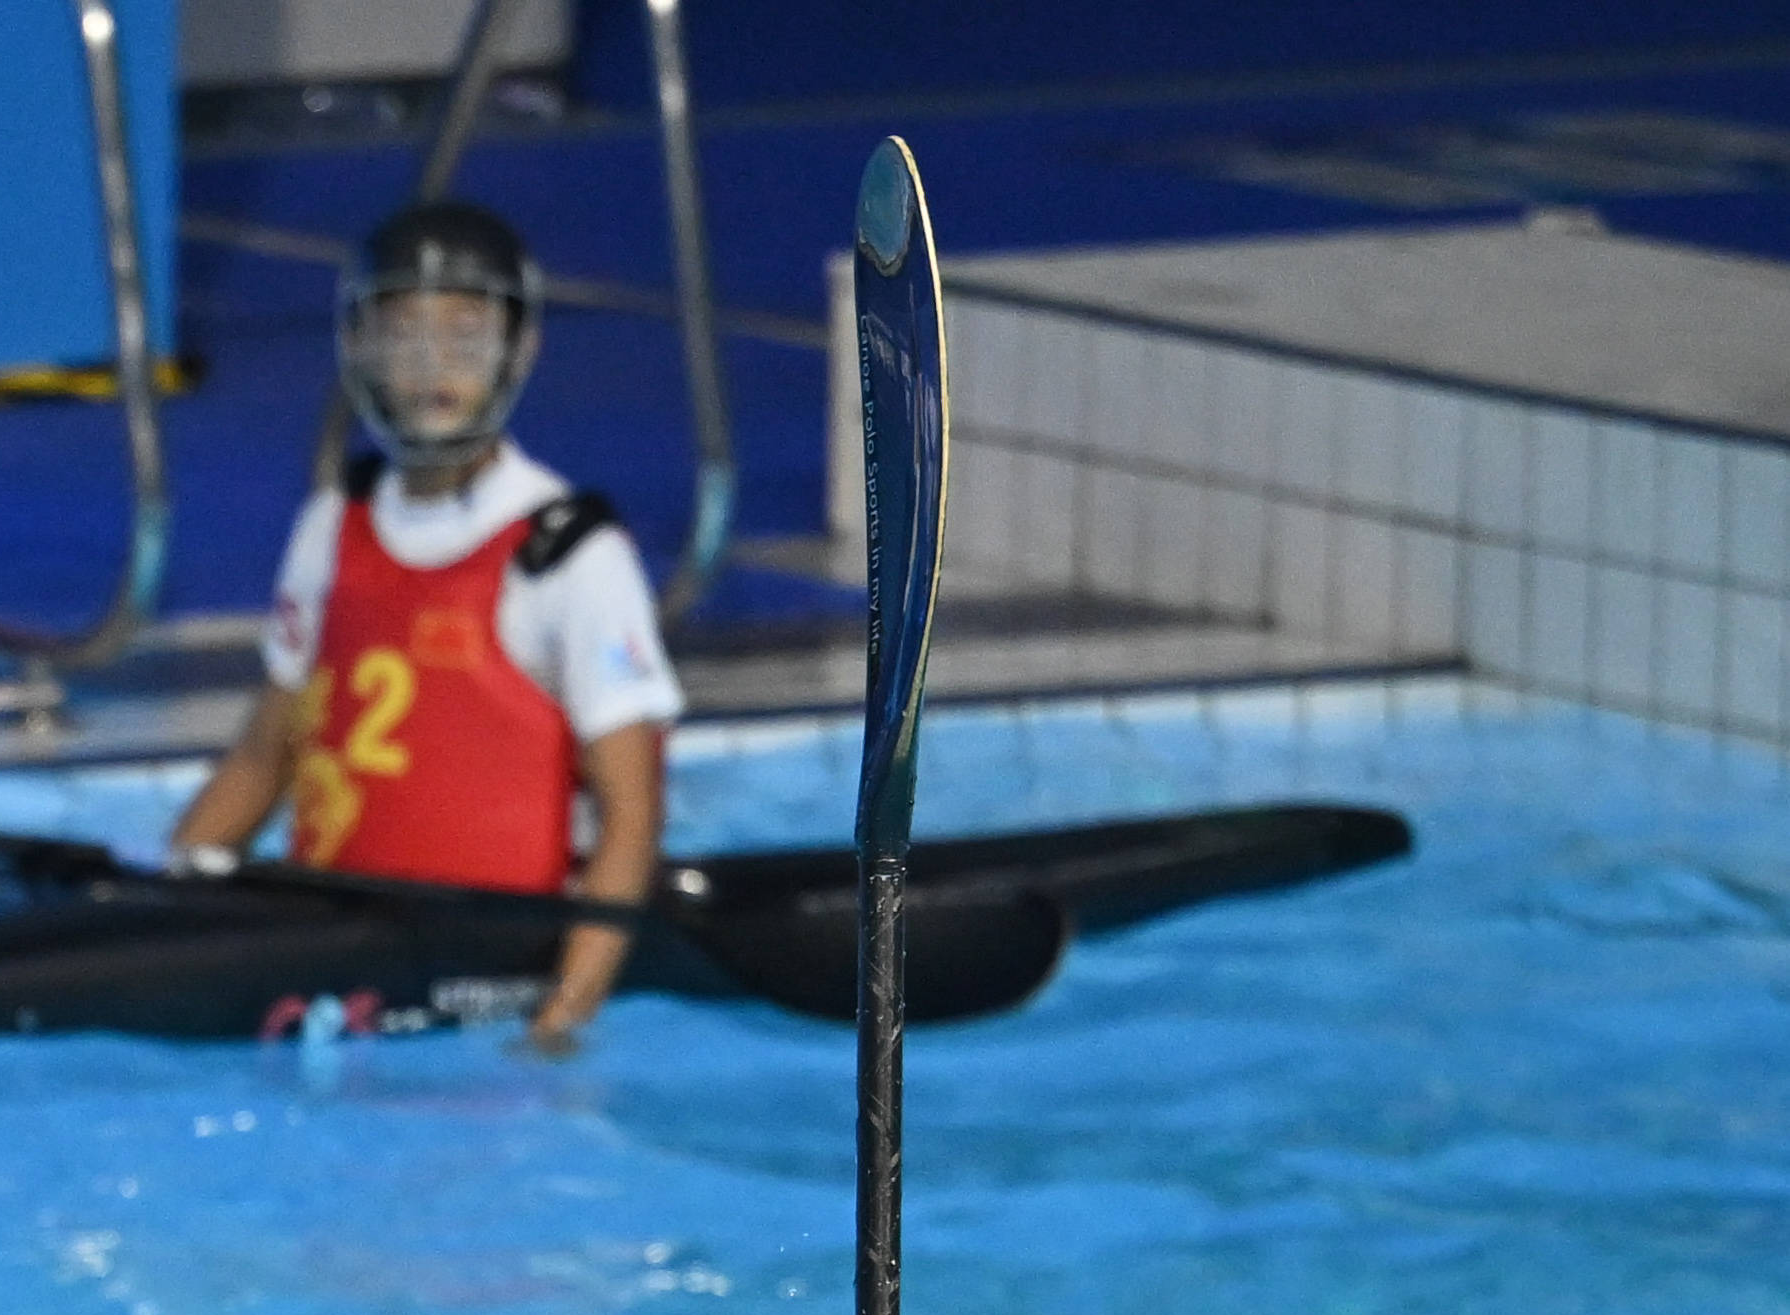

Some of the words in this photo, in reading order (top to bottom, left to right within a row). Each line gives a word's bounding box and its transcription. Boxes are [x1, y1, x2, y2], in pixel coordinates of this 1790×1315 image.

[864, 401, 877, 455] Polo
[867, 462, 879, 540] Sports
[871, 546, 882, 570] in
[870, 577, 880, 612] my
[345, 646, 416, 778] 2
